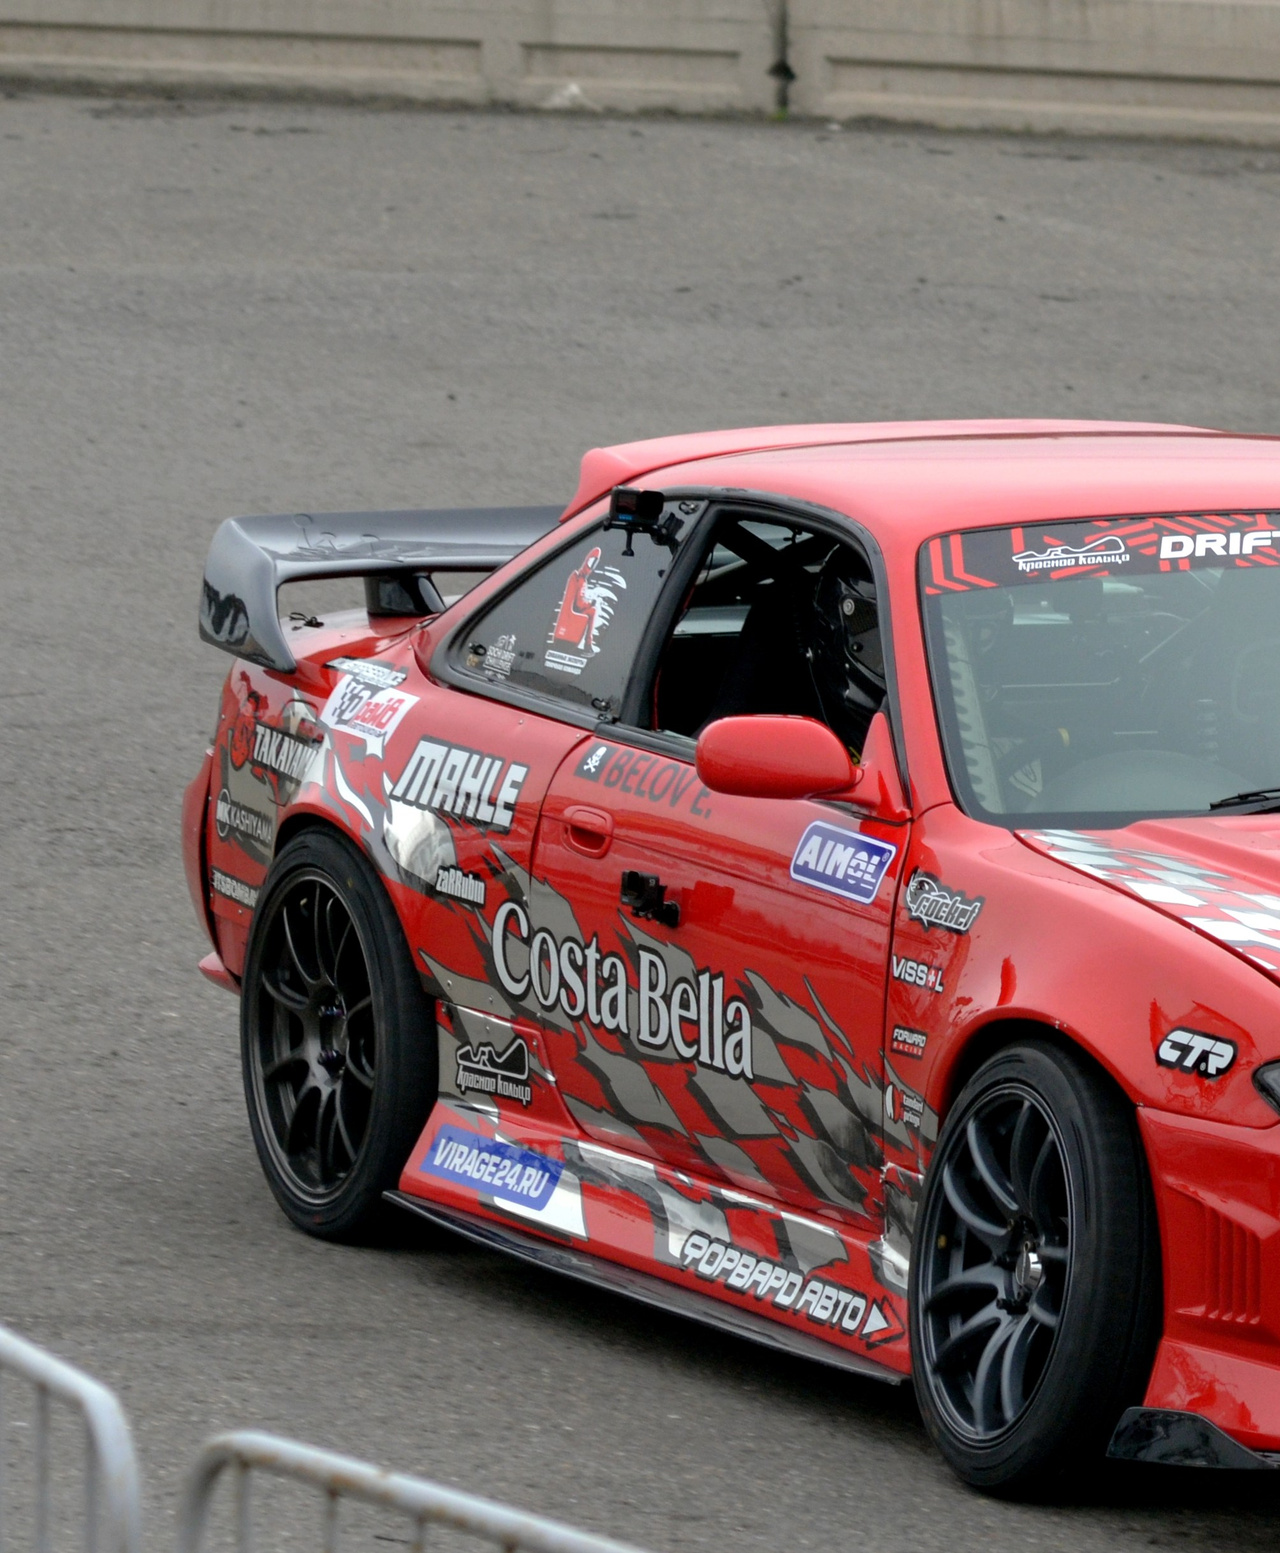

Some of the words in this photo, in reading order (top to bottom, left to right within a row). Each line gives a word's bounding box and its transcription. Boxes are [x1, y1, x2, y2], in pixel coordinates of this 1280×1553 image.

[392, 740, 528, 828] MAHLE
[604, 749, 698, 808] BELOV
[796, 835, 881, 890] AIMOL
[492, 901, 629, 1035] Costa
[638, 949, 754, 1080] Bella
[893, 1028, 927, 1048] FORWARD
[1159, 1030, 1234, 1075] CTR
[433, 1138, 550, 1199] VIRAGE24.RU
